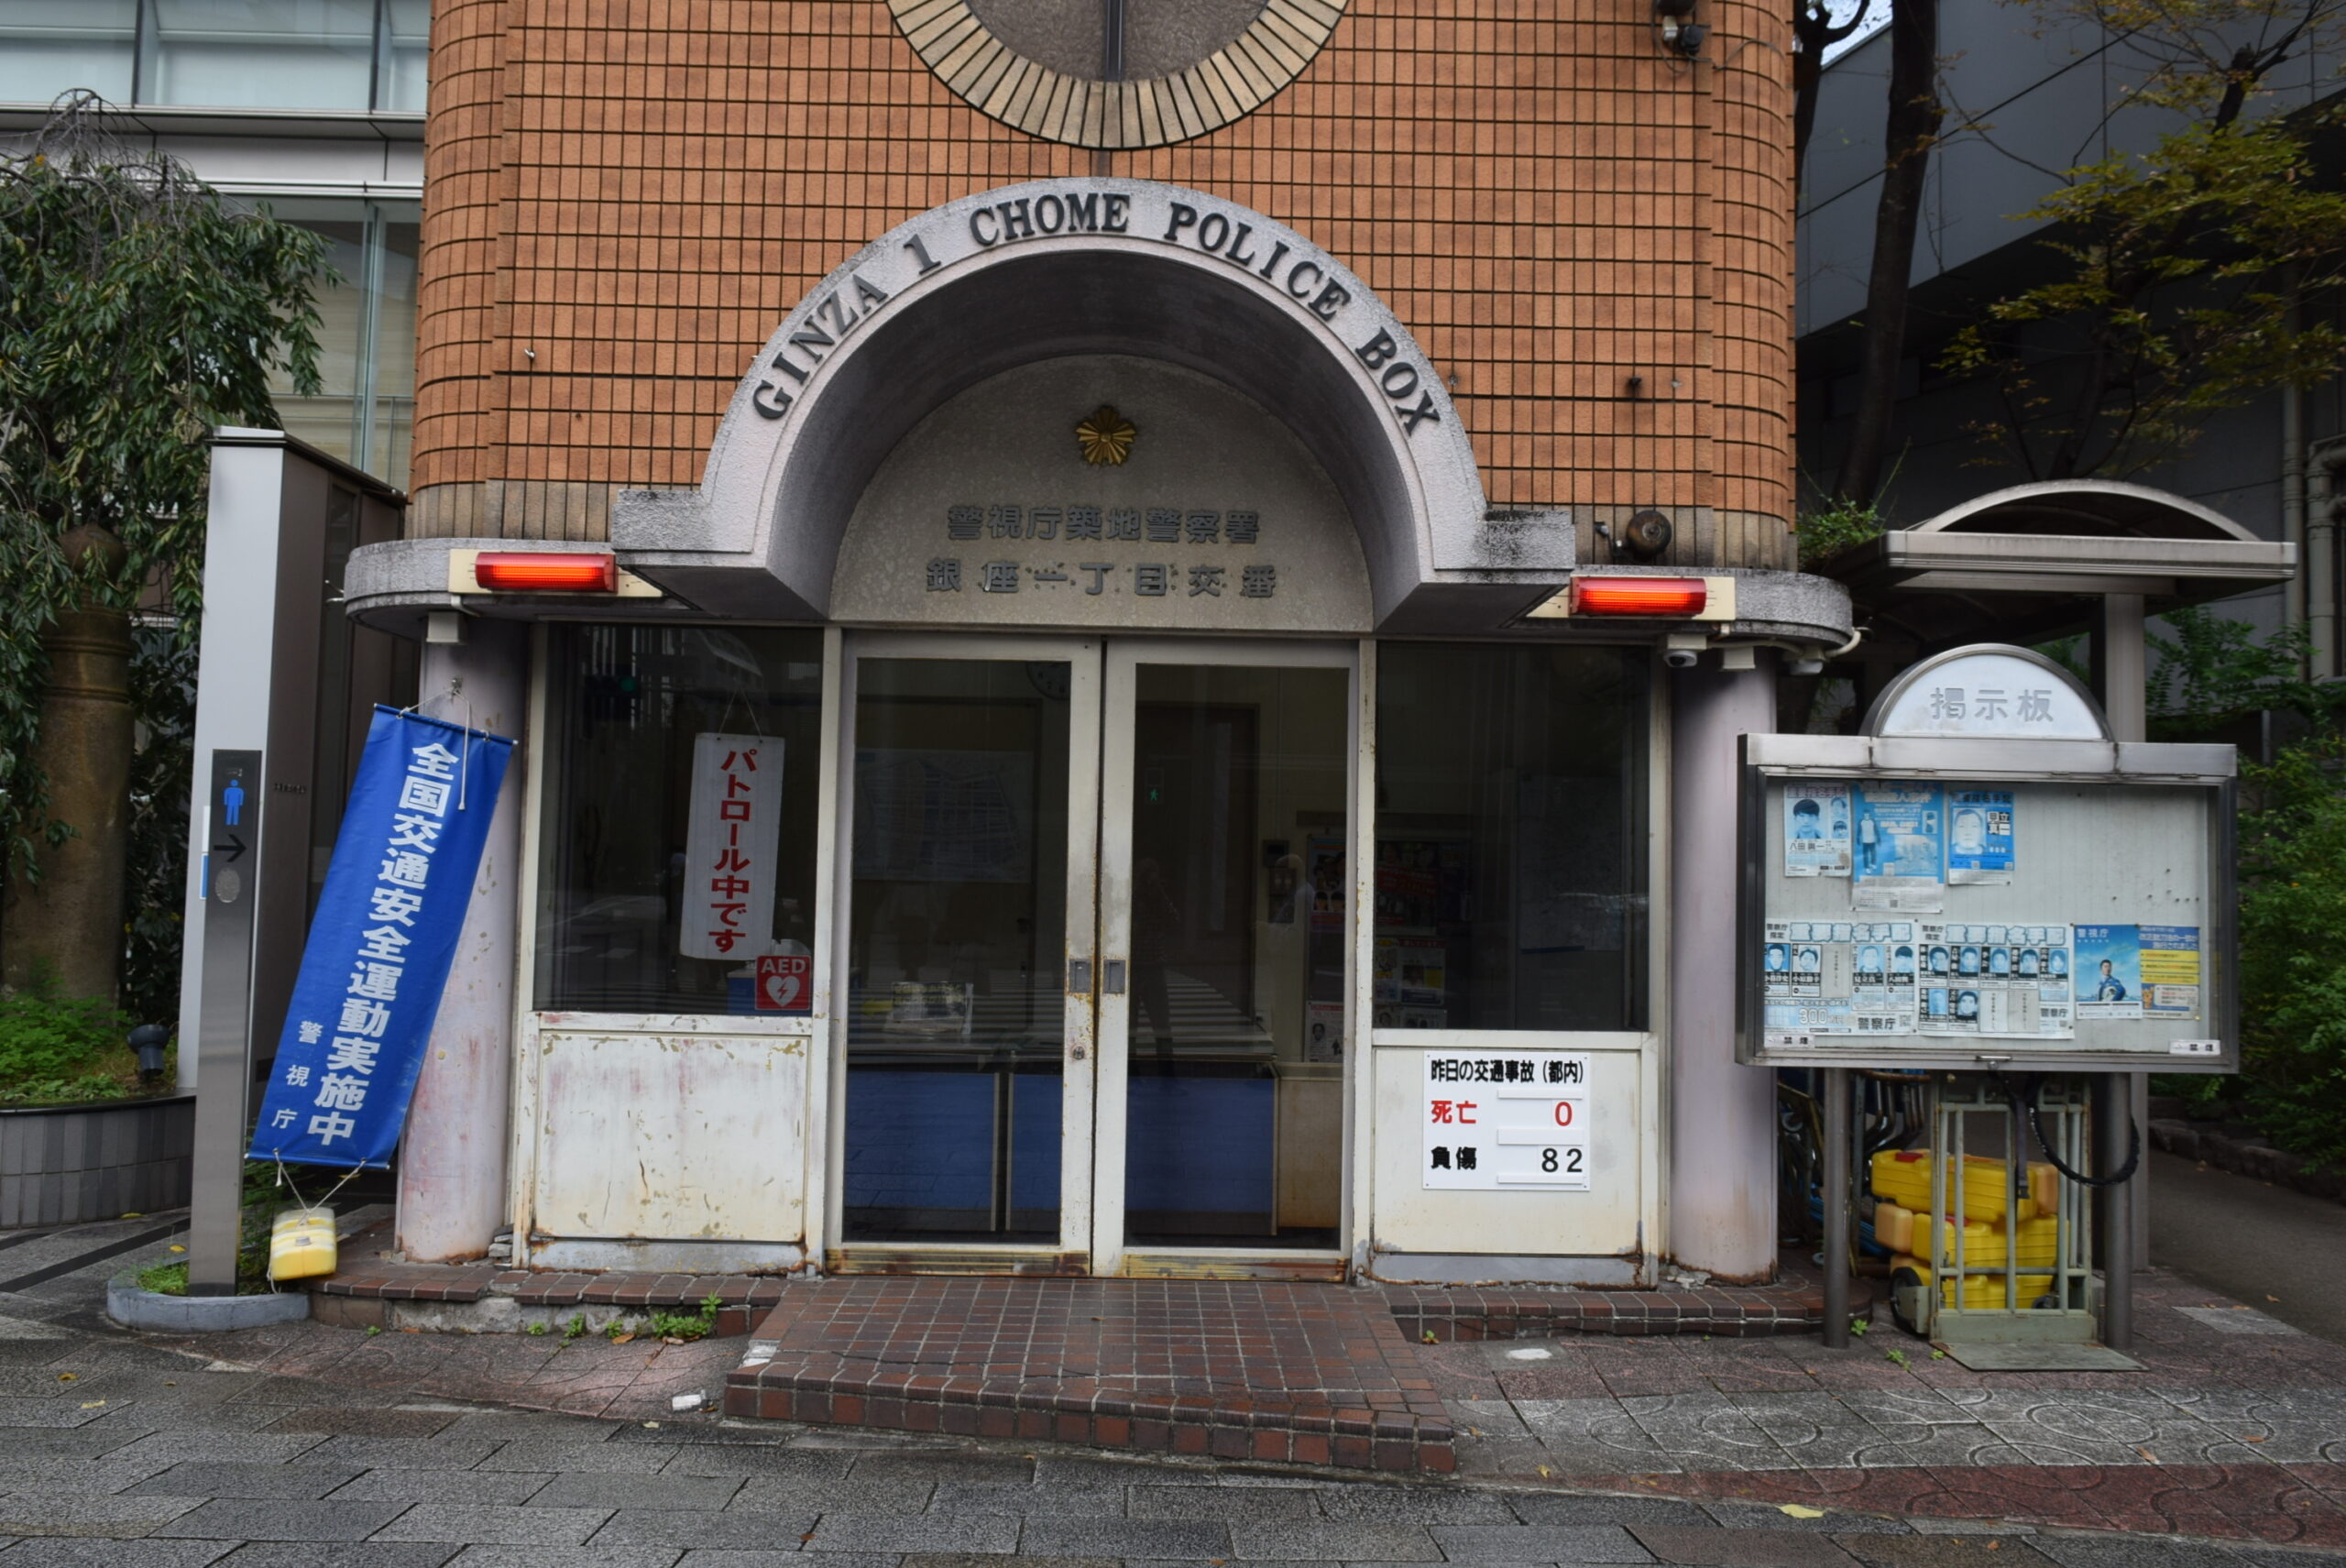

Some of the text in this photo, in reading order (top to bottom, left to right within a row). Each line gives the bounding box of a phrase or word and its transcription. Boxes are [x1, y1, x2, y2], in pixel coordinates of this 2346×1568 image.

[753, 192, 1442, 437] GINZA 1 CHOME POLICE BOX
[948, 505, 1261, 544] 警視庁築地警察署
[926, 558, 1277, 598] 銀座一丁目交番
[1930, 686, 2055, 722] 掲示板
[707, 748, 759, 953] パトロール中です
[307, 741, 459, 1146] 全国交通安全運動実施中
[2077, 928, 2109, 938] 警視庁
[761, 958, 806, 974] AED
[1858, 1017, 1897, 1030] 警察庁
[270, 1020, 324, 1130] 警視庁
[1431, 1059, 1584, 1084] 昨日の交通事故（都内）
[1431, 1100, 1573, 1126] 死亡 0
[1431, 1146, 1583, 1173] 負傷 82
